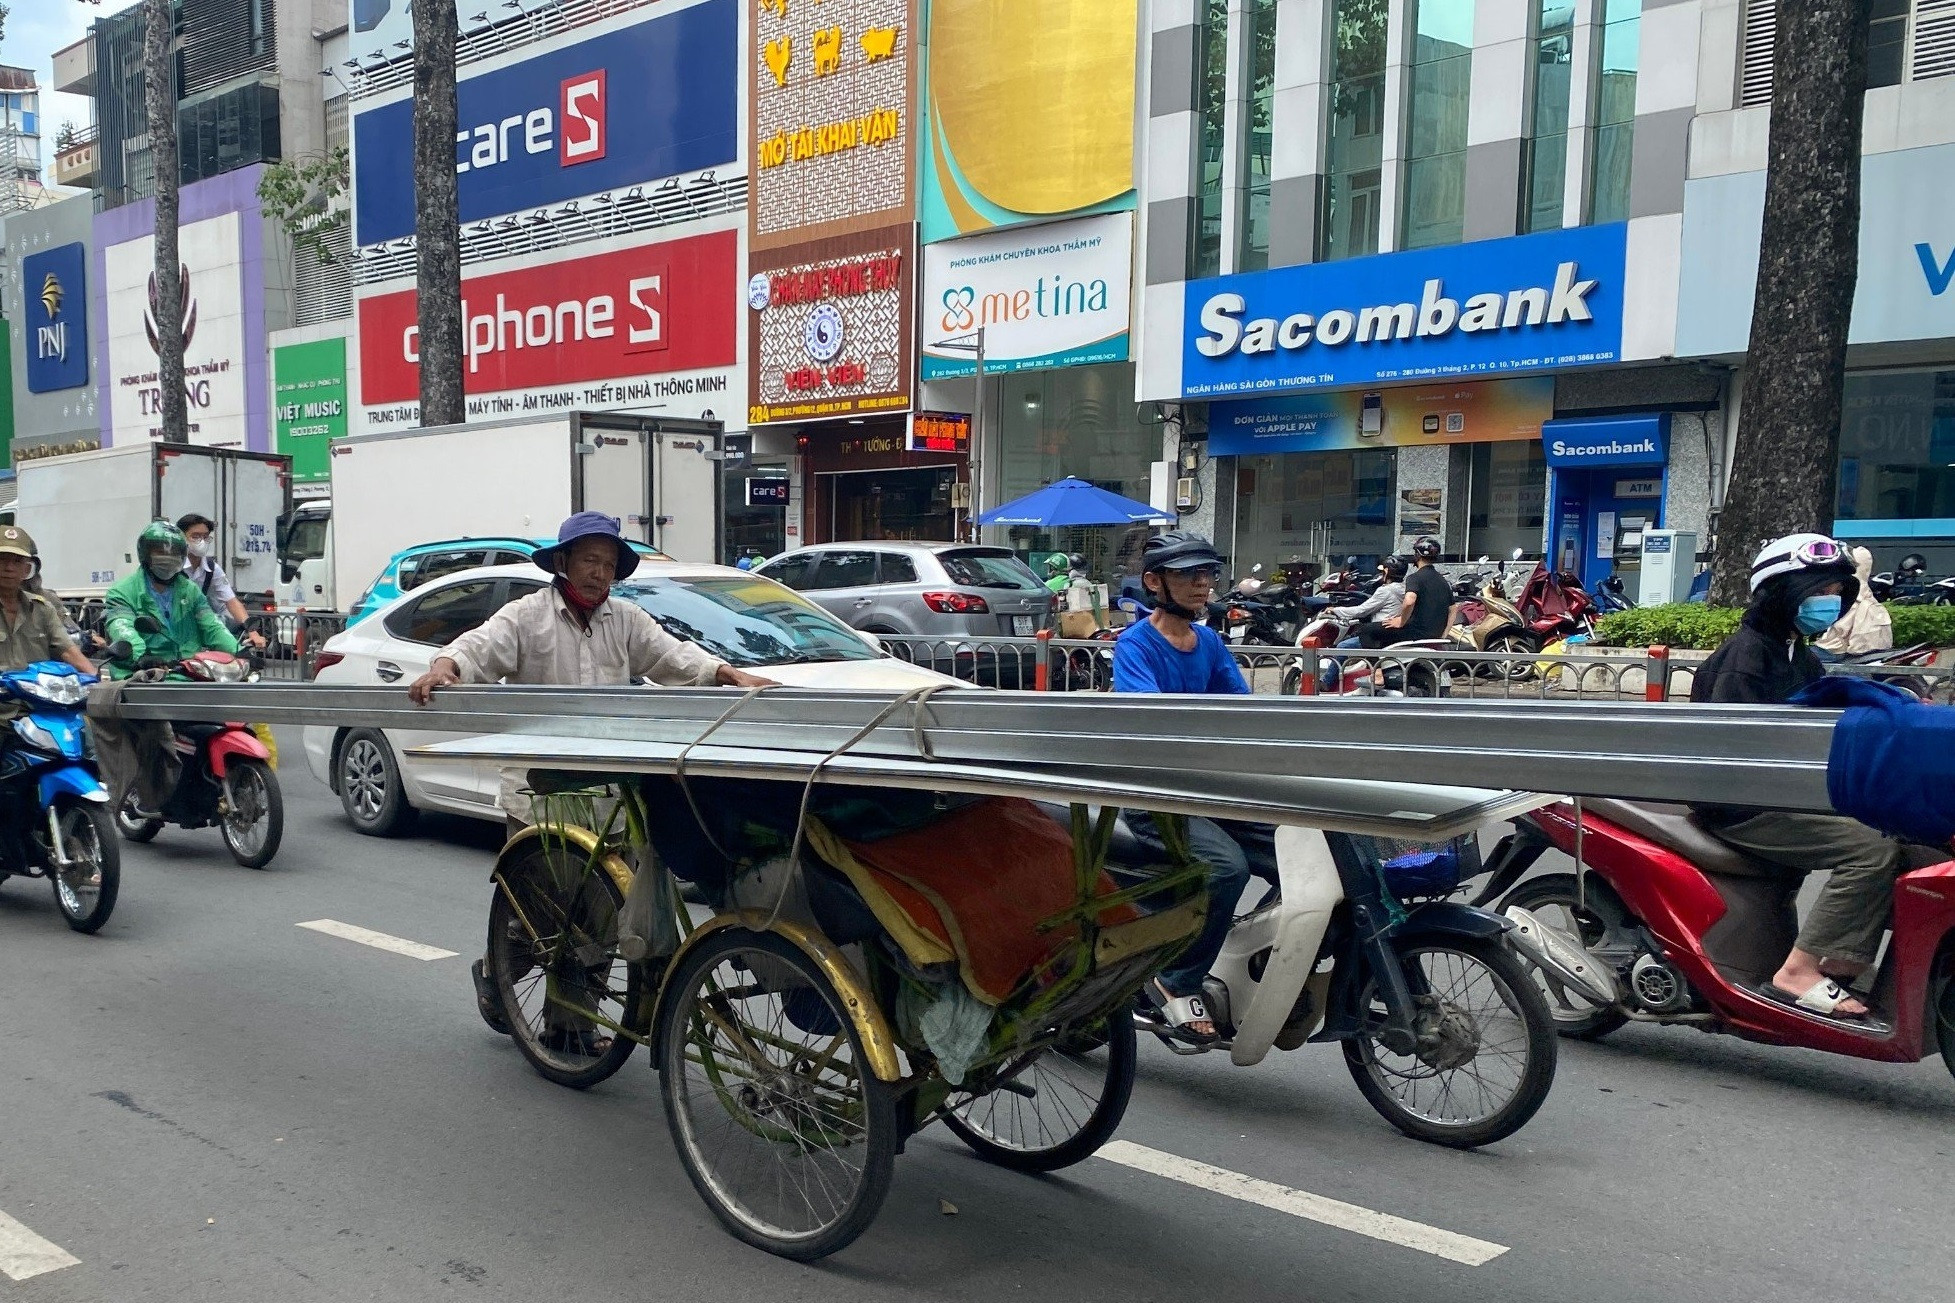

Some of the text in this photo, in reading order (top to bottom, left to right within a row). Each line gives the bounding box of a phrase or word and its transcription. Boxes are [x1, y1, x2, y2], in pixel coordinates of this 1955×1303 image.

[760, 129, 787, 169] MỞ
[818, 119, 858, 155] KHAI
[861, 106, 899, 147] VẬN
[950, 257, 977, 269] PHÒNG
[979, 254, 1001, 264] KHÁM
[1003, 246, 1036, 260] CHUYÊN
[1038, 244, 1061, 255] KHOA
[982, 274, 1108, 325] metina
[1195, 261, 1600, 358] Sacombank
[38, 323, 68, 360] PNJ
[403, 293, 615, 374] clphone
[1186, 373, 1334, 395] NGÂN HÀNG SÀI GÒN THƯƠNG TÍN
[138, 380, 210, 416] TRNG
[368, 411, 394, 425] TRUNG
[394, 407, 412, 422] TÂM
[469, 396, 488, 415] MÁY
[491, 396, 513, 413] TÍNH
[523, 394, 538, 411] ÂM
[540, 391, 574, 408] THANH
[584, 383, 614, 404] THIẾT
[616, 386, 626, 404] BỊ
[628, 380, 651, 400] NHÀ
[654, 377, 693, 397] THÔNG
[695, 375, 727, 392] MINH
[277, 400, 341, 424] VIỆT MUSIC
[750, 405, 769, 423] 284
[1234, 414, 1254, 425] ĐƠN
[1267, 423, 1296, 433] APPLE
[1298, 421, 1317, 431] PAY
[1552, 438, 1655, 456] Sacombank
[753, 487, 776, 496] care
[1629, 483, 1652, 493] ATM
[250, 524, 264, 536] 50H
